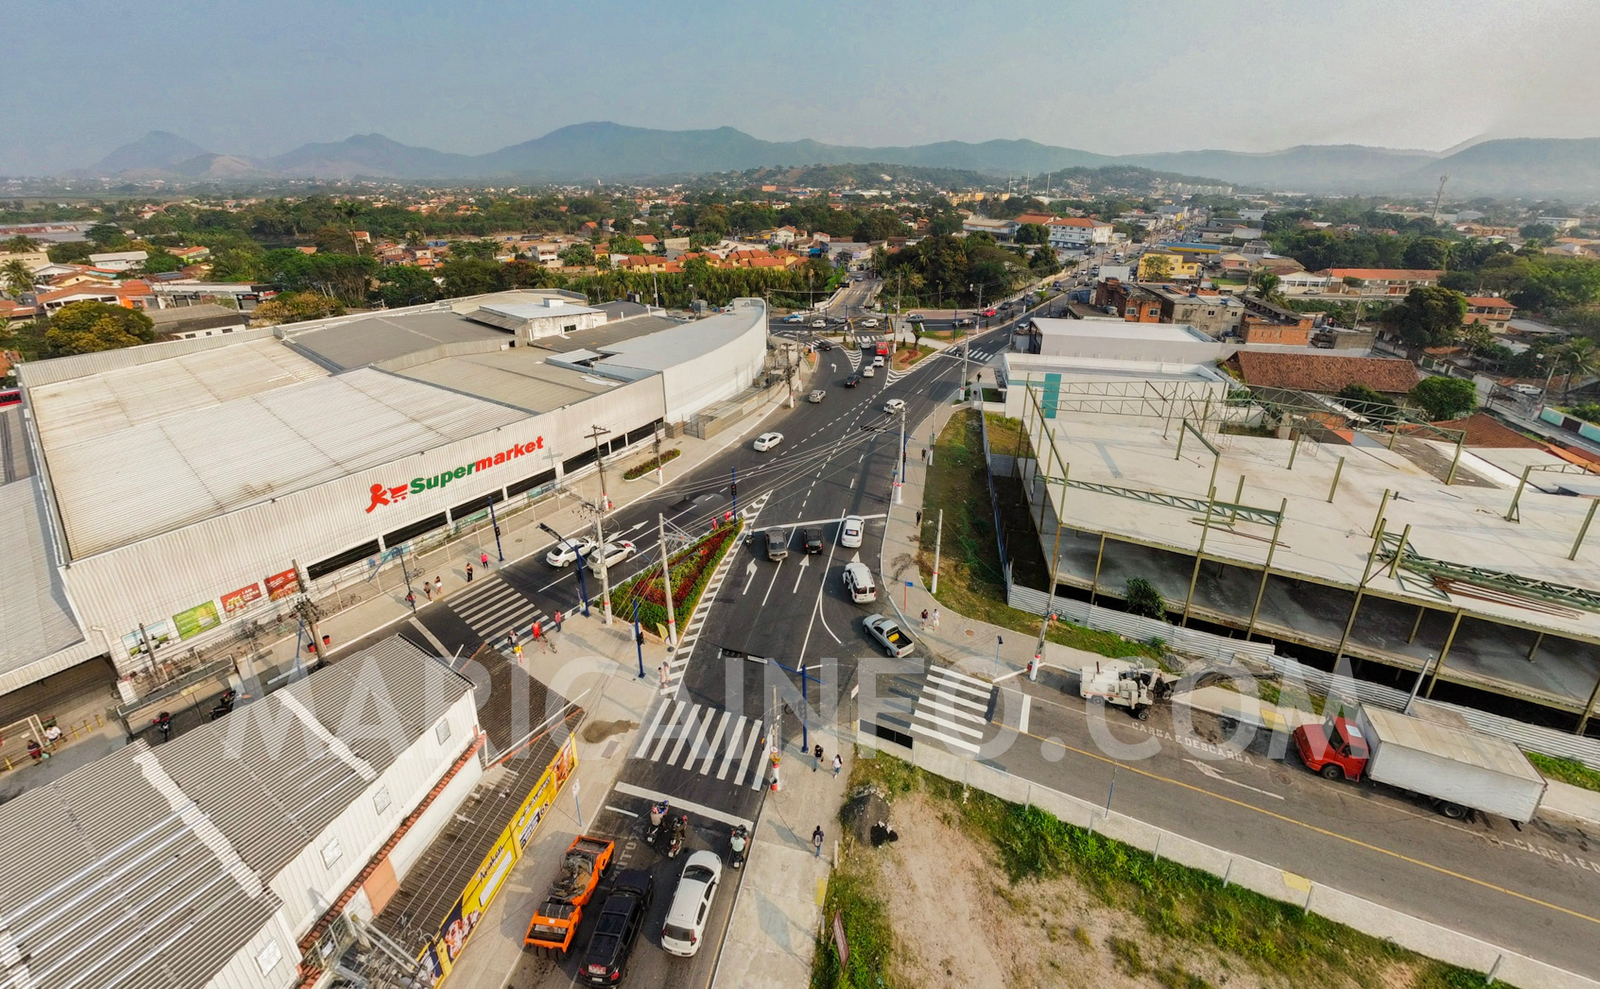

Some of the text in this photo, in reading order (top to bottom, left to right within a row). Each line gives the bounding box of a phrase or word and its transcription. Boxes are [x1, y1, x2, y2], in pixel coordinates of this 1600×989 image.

[410, 435, 544, 494] Supermarket
[1131, 722, 1254, 766] CARGA E DESCARGA
[1513, 838, 1577, 867] CARGA
[1574, 857, 1591, 871] E
